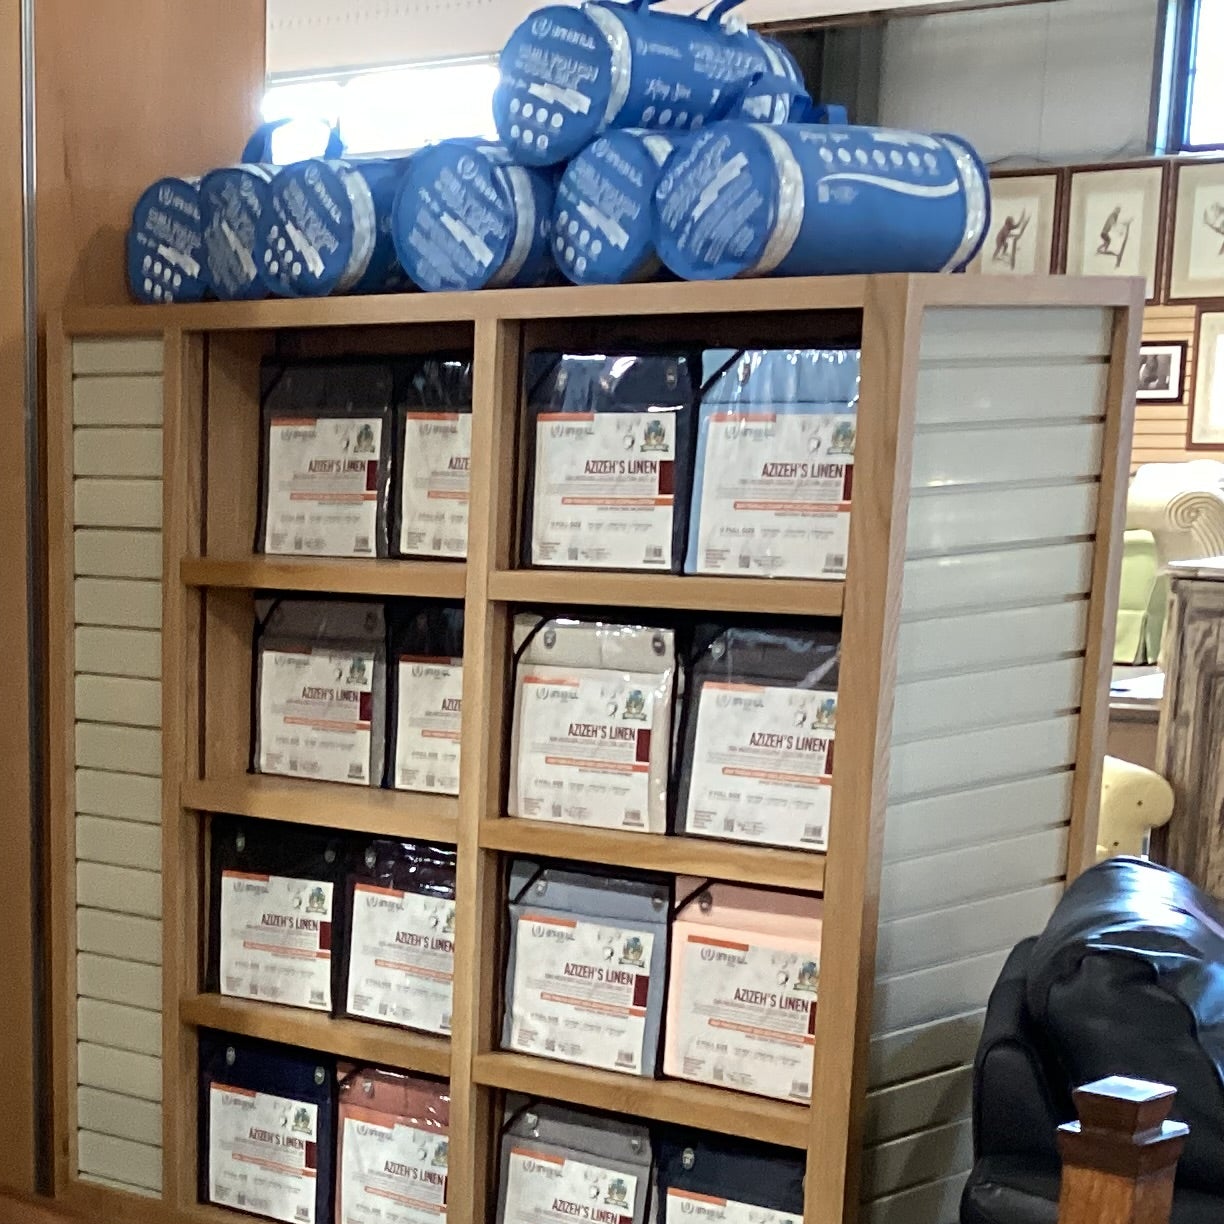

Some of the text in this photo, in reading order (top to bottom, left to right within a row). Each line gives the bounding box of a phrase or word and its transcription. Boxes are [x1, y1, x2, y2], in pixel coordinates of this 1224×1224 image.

[448, 457, 470, 470] AZIZE
[585, 460, 657, 474] AZIZEH'S LINEN
[762, 463, 843, 478] AZIZEH'S LINEN
[568, 724, 635, 741] AZIZEH'S LINEN
[749, 732, 826, 752] AZIZEH'S LINEN
[564, 963, 633, 985] AZIZEH'S LINEN
[734, 988, 809, 1013] AZIZEH'S LINEN
[552, 1198, 617, 1224] AZIZEH'S LINEN
